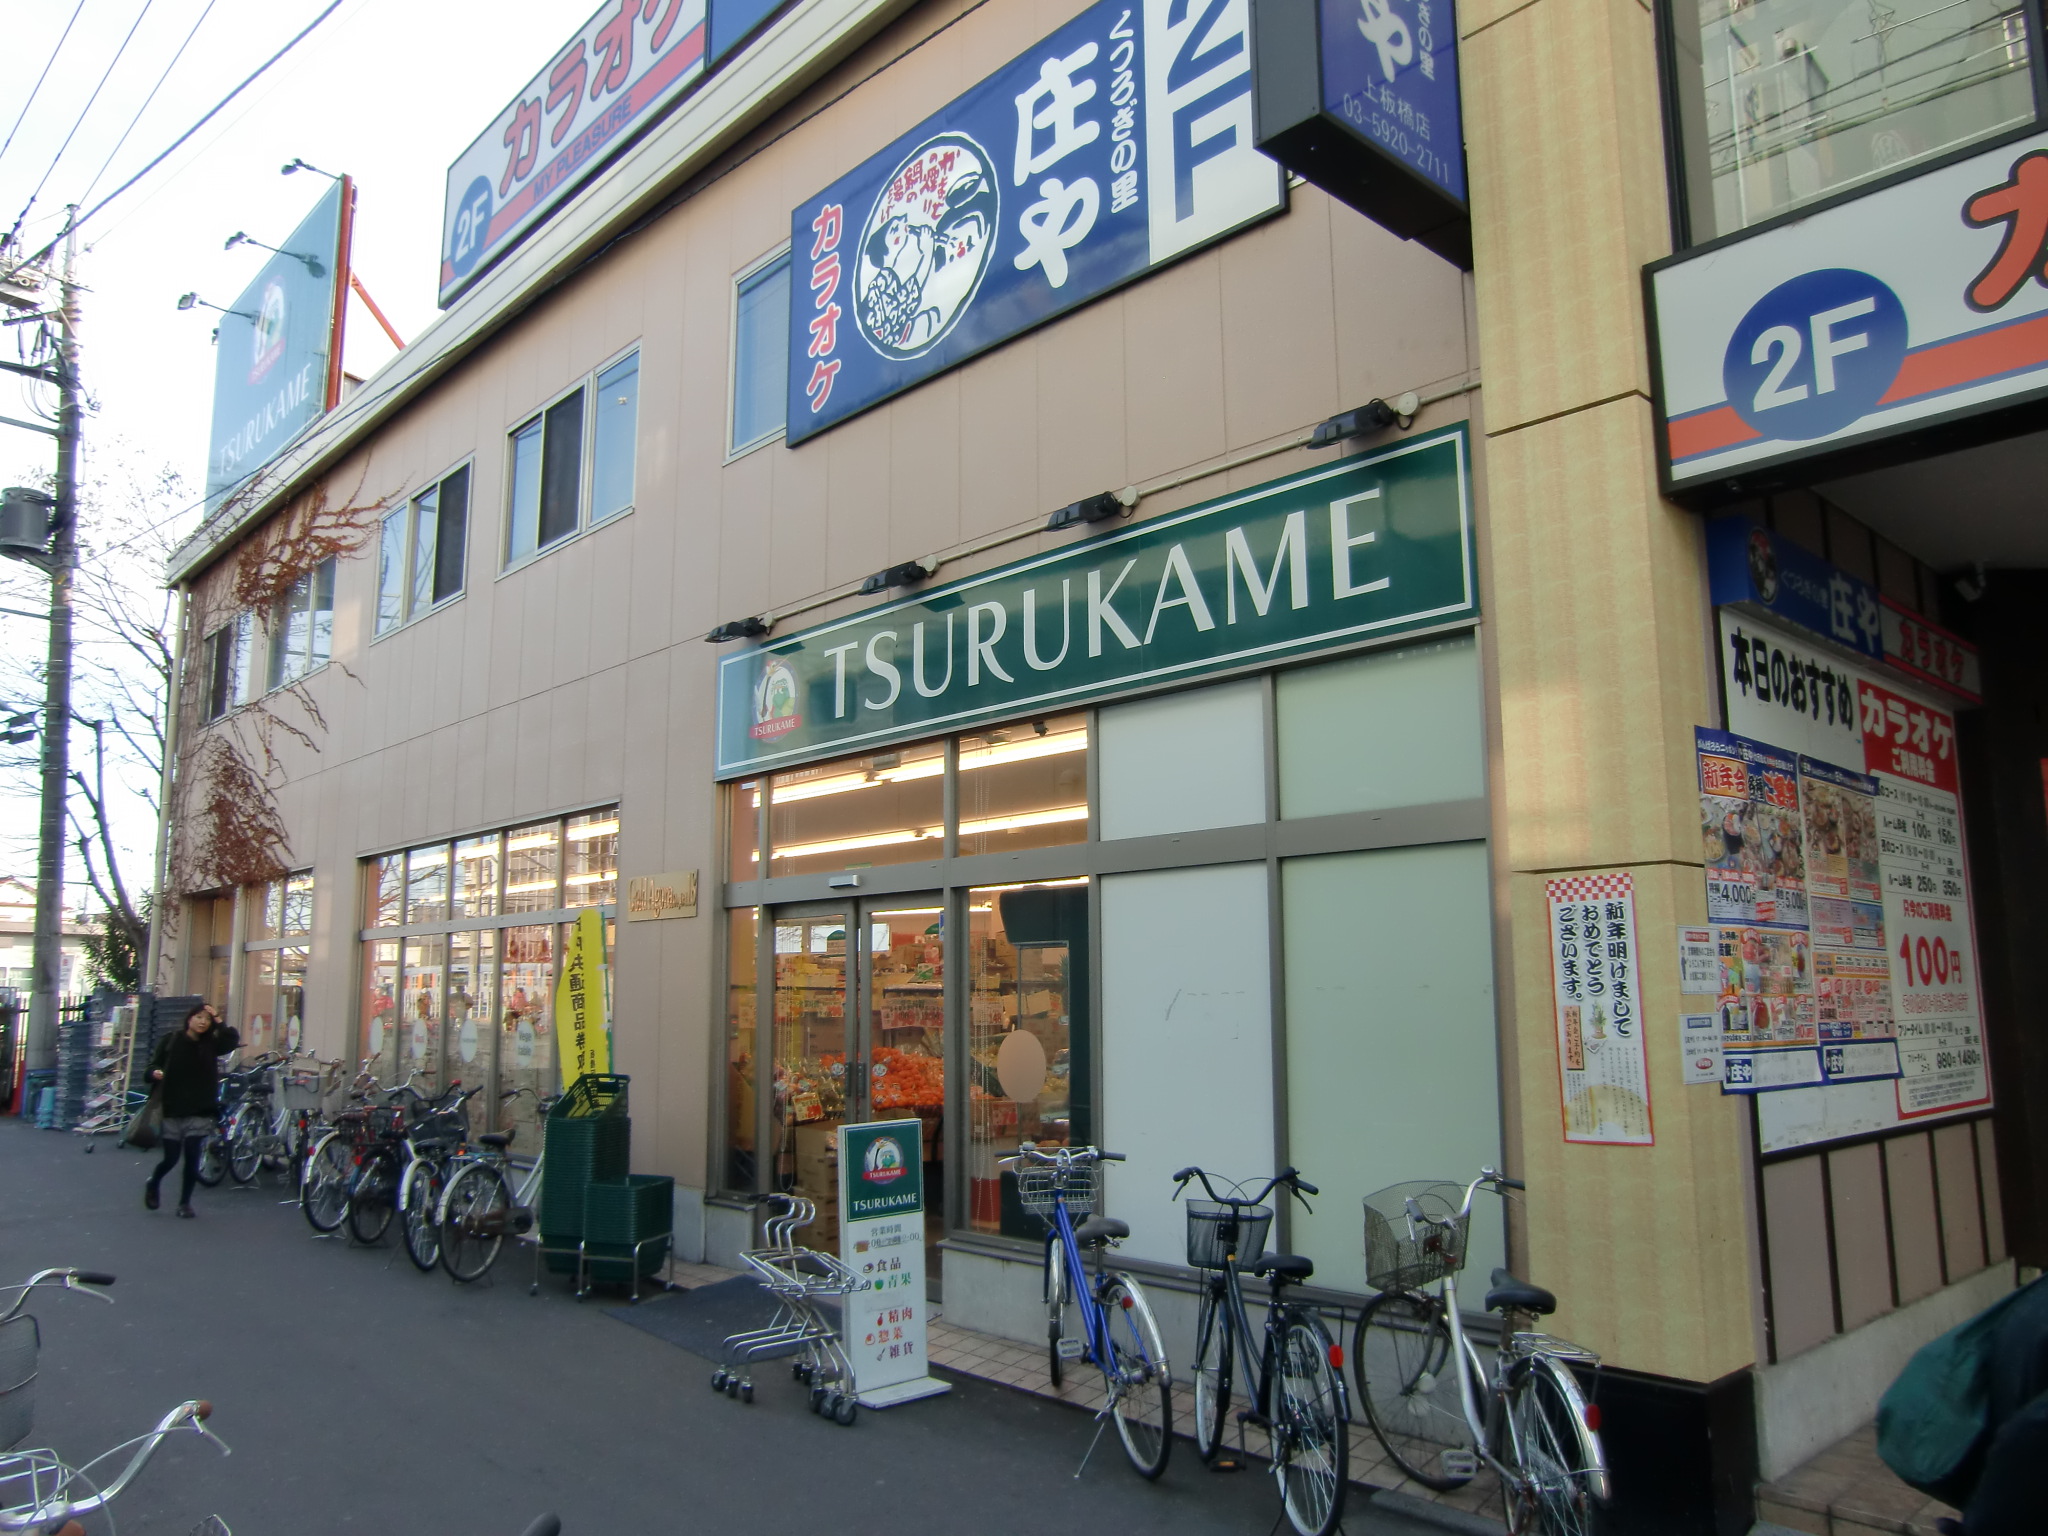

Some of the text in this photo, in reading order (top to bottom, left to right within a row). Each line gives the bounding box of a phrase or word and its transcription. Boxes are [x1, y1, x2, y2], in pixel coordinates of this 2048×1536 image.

[1108, 9, 1140, 214] くつろぎの里
[1343, 93, 1449, 184] 03-5920-2711
[1363, 74, 1431, 142] 上板橋店
[533, 95, 633, 201] MY PLEASURE
[1014, 41, 1100, 289] 庄や
[455, 191, 488, 262] 2F
[806, 203, 843, 413] カラオケ
[1751, 296, 1876, 413] 2F
[219, 363, 311, 477] TSURUKAME
[824, 487, 1390, 719] TSURUKAME
[1828, 571, 1881, 654] 庄や
[1731, 626, 1854, 731] 本日のおすすめ
[1899, 620, 1965, 685] カラオケ
[753, 719, 797, 738] TSURUKAME
[1861, 688, 1953, 761] カラオケ
[1702, 759, 1744, 795] 新年会
[1891, 748, 1936, 784] ご利用料金
[1902, 899, 1952, 922] 只今のご利用料金
[1559, 904, 1582, 999] ございます。
[1582, 905, 1604, 994] おめでとう
[1605, 901, 1630, 1035] 新年明けまして
[1900, 933, 1962, 987] 100円
[853, 1193, 917, 1211] TSURUKAME
[869, 1169, 901, 1178] TSURUKAME
[871, 1223, 902, 1237] 営業時間
[877, 1257, 902, 1273] 食品
[888, 1272, 912, 1288] 青果
[878, 1326, 903, 1344] 惣菜
[888, 1307, 913, 1324] 精肉
[890, 1341, 913, 1359] 雑貨
